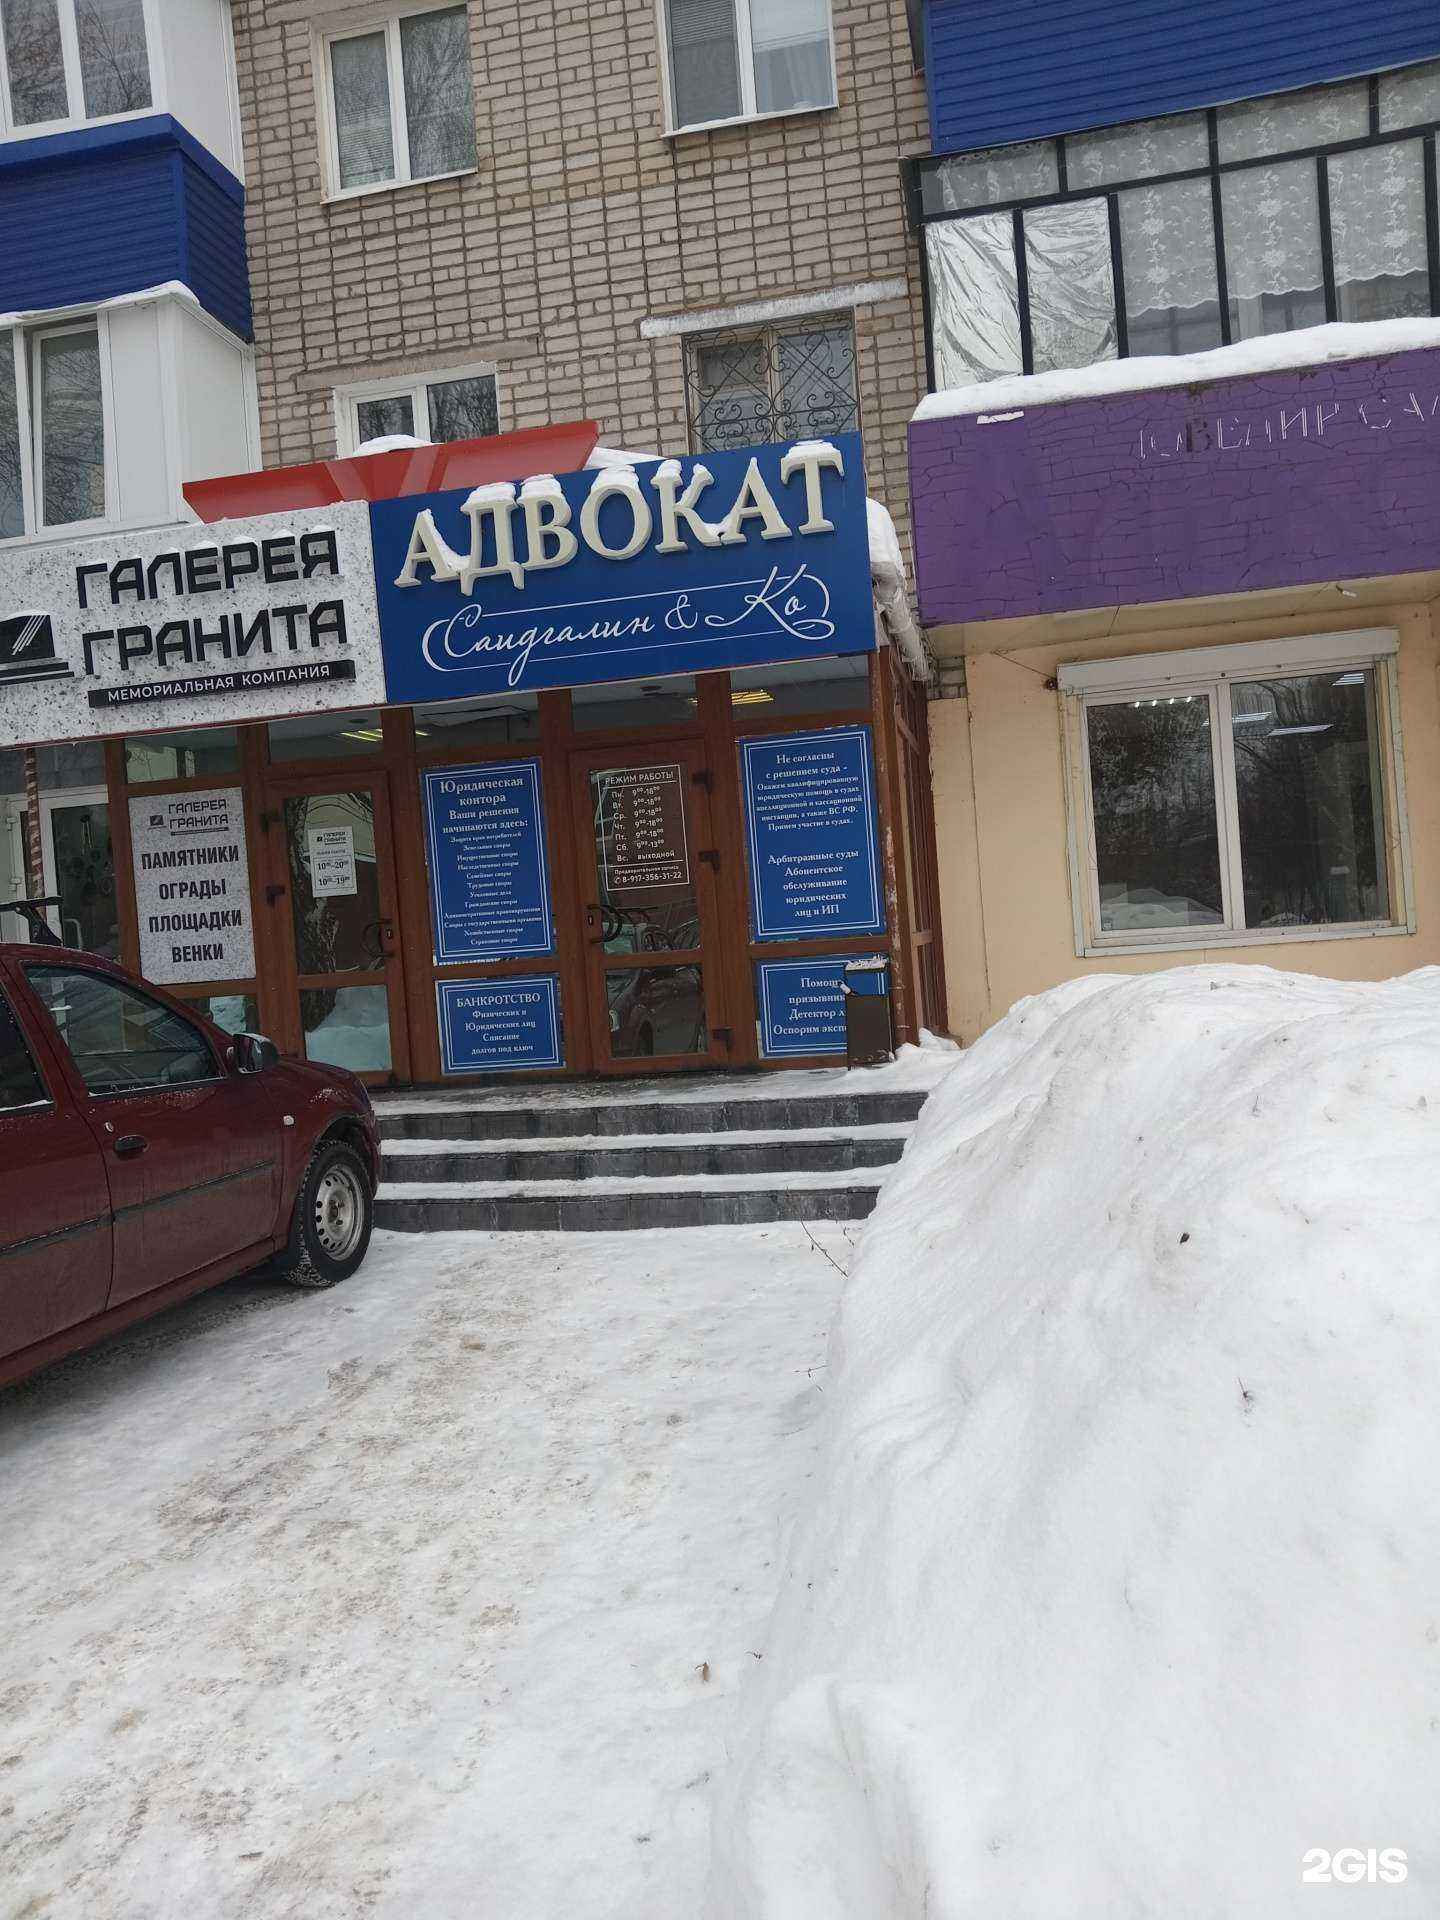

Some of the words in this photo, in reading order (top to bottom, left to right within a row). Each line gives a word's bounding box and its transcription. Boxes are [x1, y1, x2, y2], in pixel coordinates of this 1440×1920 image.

[394, 444, 845, 597] АДВОКАТ
[76, 530, 339, 609] ГАЛЕРЕЯ
[444, 604, 655, 687] Саидгалин
[664, 594, 700, 631] &
[705, 563, 835, 641] Ко
[82, 600, 347, 675] ГРАНИТА
[107, 676, 235, 702] МЕМОРИАЛЬНАЯ
[242, 664, 331, 687] КОМПАНИЯ
[777, 754, 791, 764] Не
[793, 752, 835, 763] согласны
[605, 775, 637, 785] РЕЖИМ
[640, 771, 674, 781] РАБОТЫ
[773, 768, 819, 780] решением
[820, 765, 841, 776] суда
[440, 778, 523, 794] Юридическая
[168, 799, 227, 814] ГАЛЕРЕЯ
[460, 794, 506, 807] контора
[449, 810, 476, 820] Ваши
[479, 807, 520, 819] решения
[169, 814, 228, 829] ГРАНИТА
[443, 823, 497, 834] начинаются
[499, 819, 528, 830] здесь:
[141, 845, 239, 869] ПАМЯТНИКИ
[768, 853, 834, 865] Арбитражные
[836, 850, 859, 859] суды
[622, 871, 682, 883] 8-917-356-31-22
[784, 866, 843, 877] Абонентское
[159, 879, 226, 900] ОГРАДЫ
[783, 879, 847, 891] обслуживание
[786, 893, 847, 905] юридических
[794, 910, 812, 918] лиц
[822, 904, 839, 915] ИП
[149, 910, 242, 933] ПЛОЩАДКИ
[171, 943, 224, 963] ВЕНКИ
[801, 977, 841, 988] Помощ
[456, 992, 541, 1007] БАНКРОТСТВО
[472, 1010, 520, 1019] Физических
[789, 1009, 836, 1021] Детектор
[465, 1021, 520, 1032] Юридических
[773, 1024, 820, 1036] Оспорим
[482, 1033, 520, 1041] Списание
[471, 1047, 497, 1055] долгов
